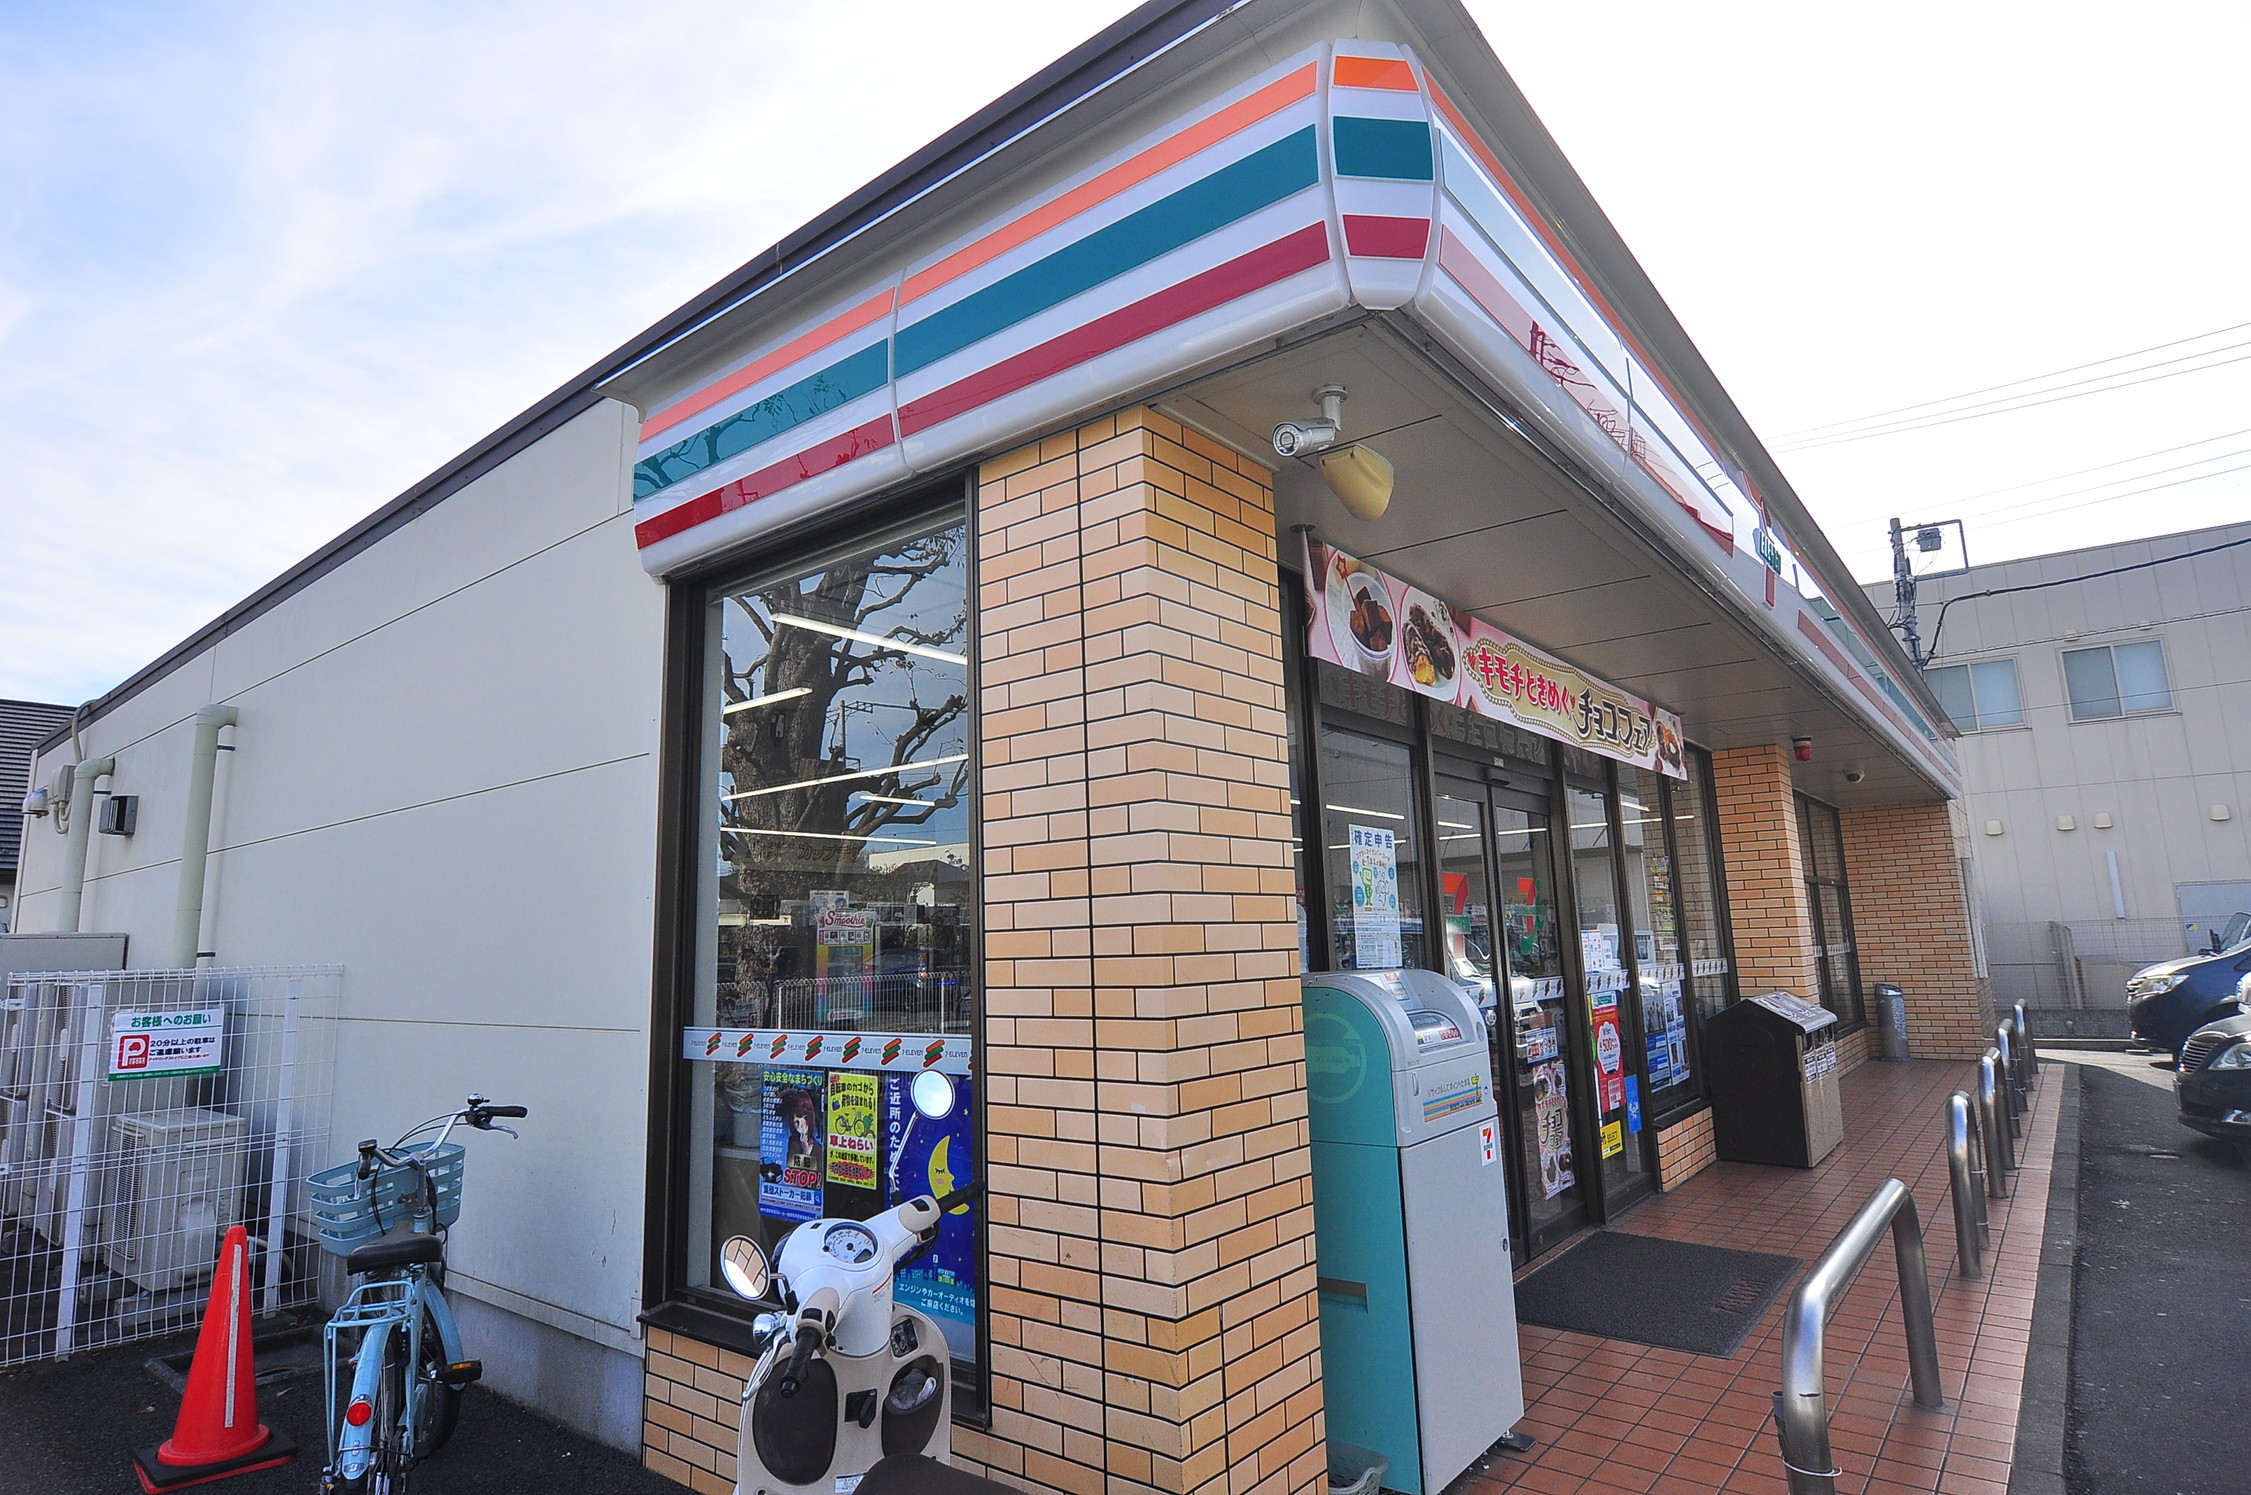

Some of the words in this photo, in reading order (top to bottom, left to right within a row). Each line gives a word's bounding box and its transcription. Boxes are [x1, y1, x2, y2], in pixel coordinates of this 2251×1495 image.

[1478, 647, 1571, 716] キモチときめく
[1572, 687, 1652, 750] チョコフェア
[1354, 830, 1392, 849] 確定申告
[825, 910, 865, 925] Smoothie
[131, 1013, 211, 1027] お客様へのお願い
[150, 1036, 216, 1047] 20分以上の駐車は
[149, 1047, 202, 1056] ご遠慮願います
[763, 1071, 823, 1086] 安心安全なまちづくり
[830, 1082, 874, 1097] 自転車のカゴから
[829, 1135, 874, 1151] 車上ねらい
[793, 1155, 811, 1168] 防犯
[784, 1168, 822, 1190] STOP!
[763, 1185, 812, 1202] 集団ストーカー犯罪
[920, 1298, 963, 1316] ご来店ください。
